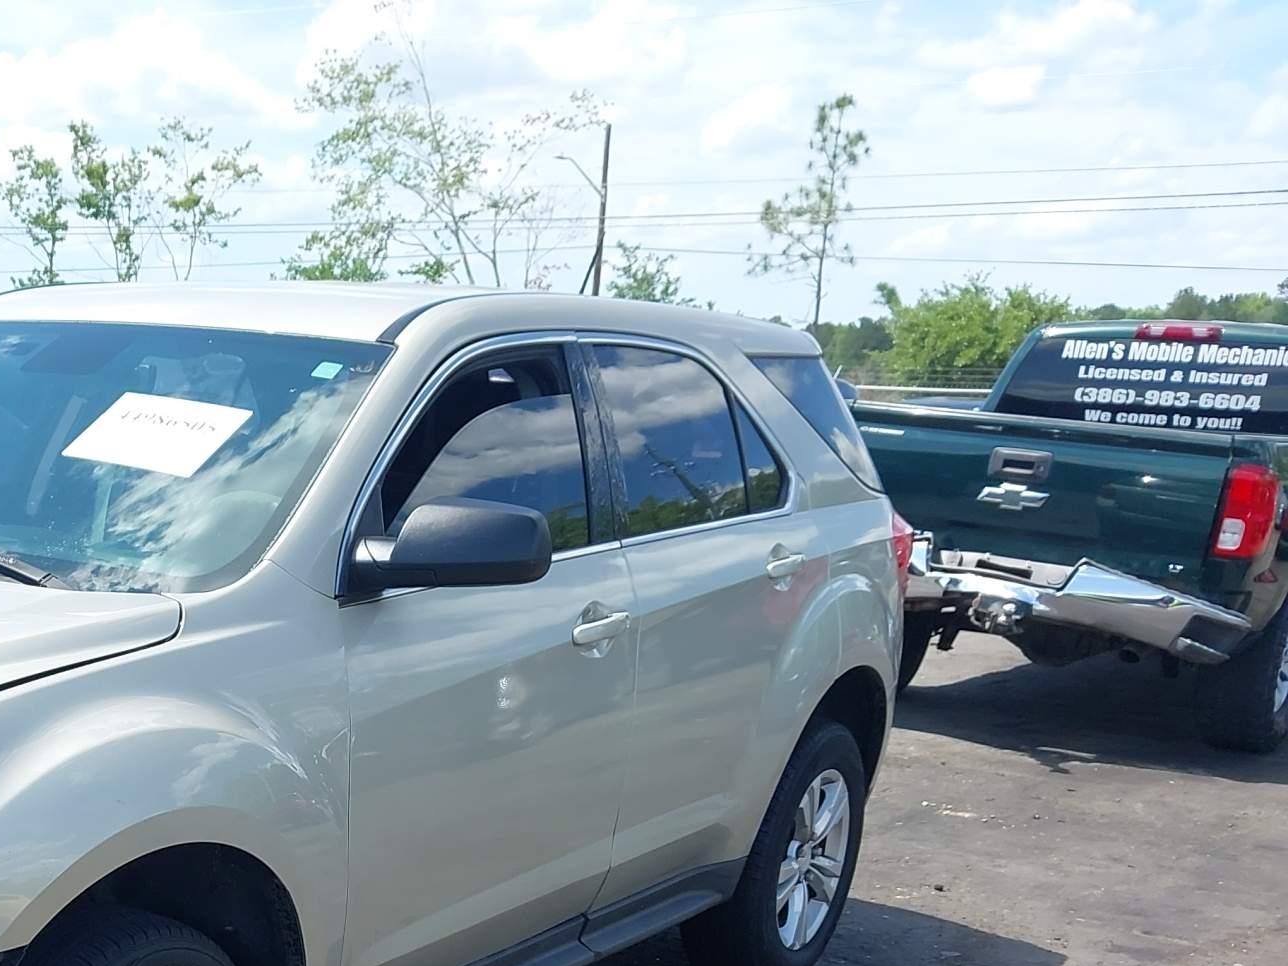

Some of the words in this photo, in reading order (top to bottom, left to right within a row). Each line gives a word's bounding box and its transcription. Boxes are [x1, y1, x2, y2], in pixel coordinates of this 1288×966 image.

[1061, 339, 1126, 361] Allen's
[1128, 341, 1194, 363] Mobile
[1078, 365, 1166, 382] Licensed
[1170, 370, 1184, 383] &
[1188, 369, 1269, 387] Insured
[1074, 387, 1261, 411] (386)-983-6604
[1084, 408, 1112, 423] We
[1115, 411, 1168, 426] come
[1172, 413, 1192, 427] to
[1195, 416, 1244, 431] you!!
